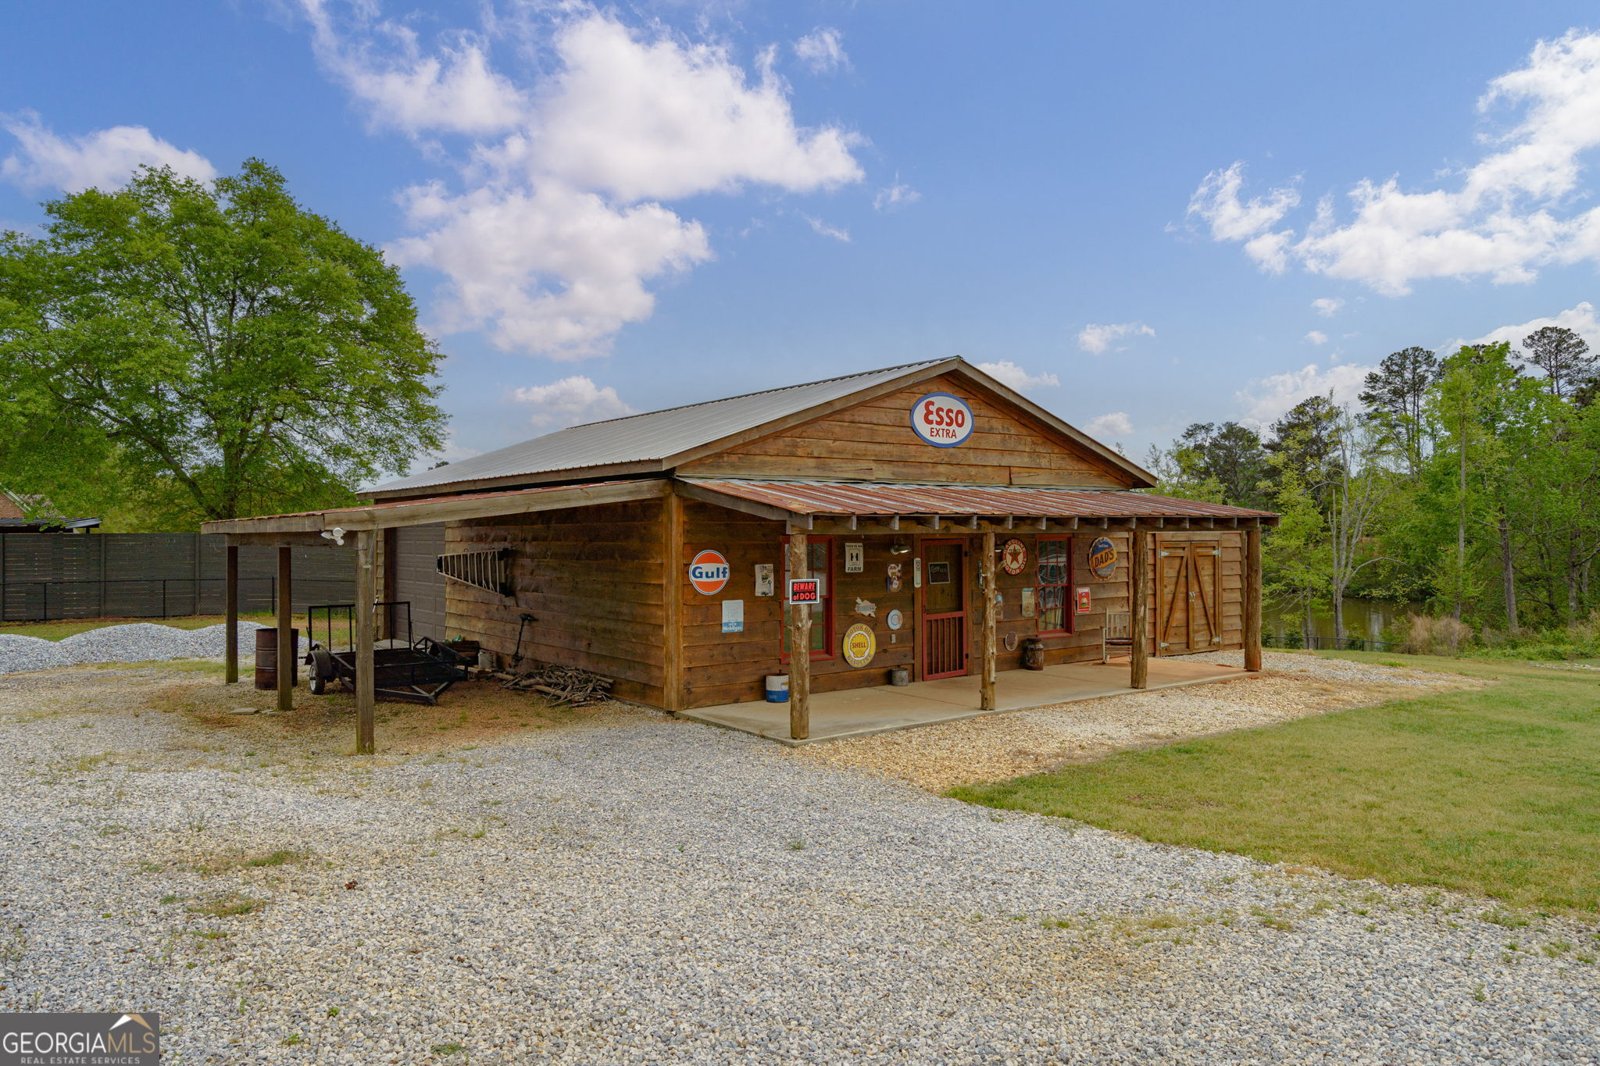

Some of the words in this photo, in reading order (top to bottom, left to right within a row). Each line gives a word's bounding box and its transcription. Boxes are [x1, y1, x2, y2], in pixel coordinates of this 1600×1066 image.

[923, 400, 966, 428] ESSO
[929, 427, 957, 439] EXTRA
[691, 566, 728, 578] Gulf
[793, 582, 816, 591] BEWARE
[799, 592, 816, 600] DOG
